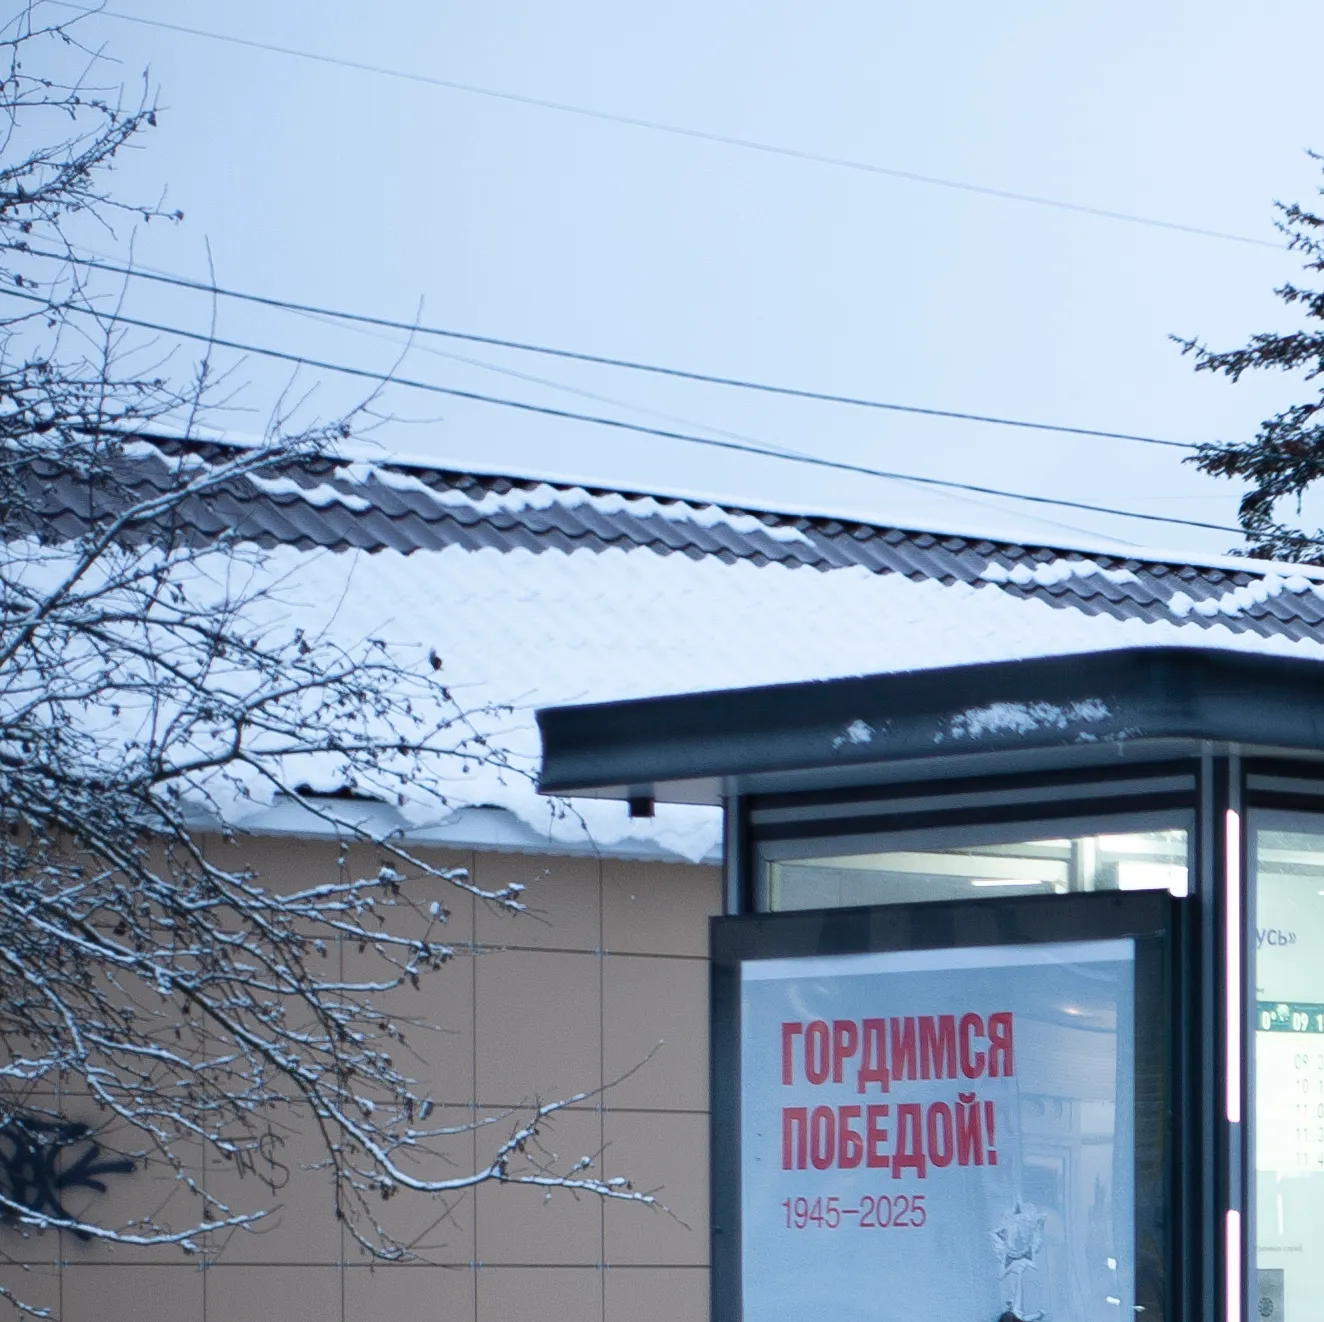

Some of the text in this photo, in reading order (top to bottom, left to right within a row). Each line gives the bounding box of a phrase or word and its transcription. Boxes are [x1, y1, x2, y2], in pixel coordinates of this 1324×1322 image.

[1292, 1012, 1309, 1032] 09
[781, 1011, 1013, 1094] ГОРДИМСЯ
[1295, 1054, 1309, 1070] 09
[1296, 1078, 1308, 1094] 10
[1296, 1103, 1308, 1119] 11
[782, 1092, 997, 1179] ПОБЕДОЙ!
[1296, 1127, 1308, 1143] 11
[1296, 1151, 1308, 1167] 11
